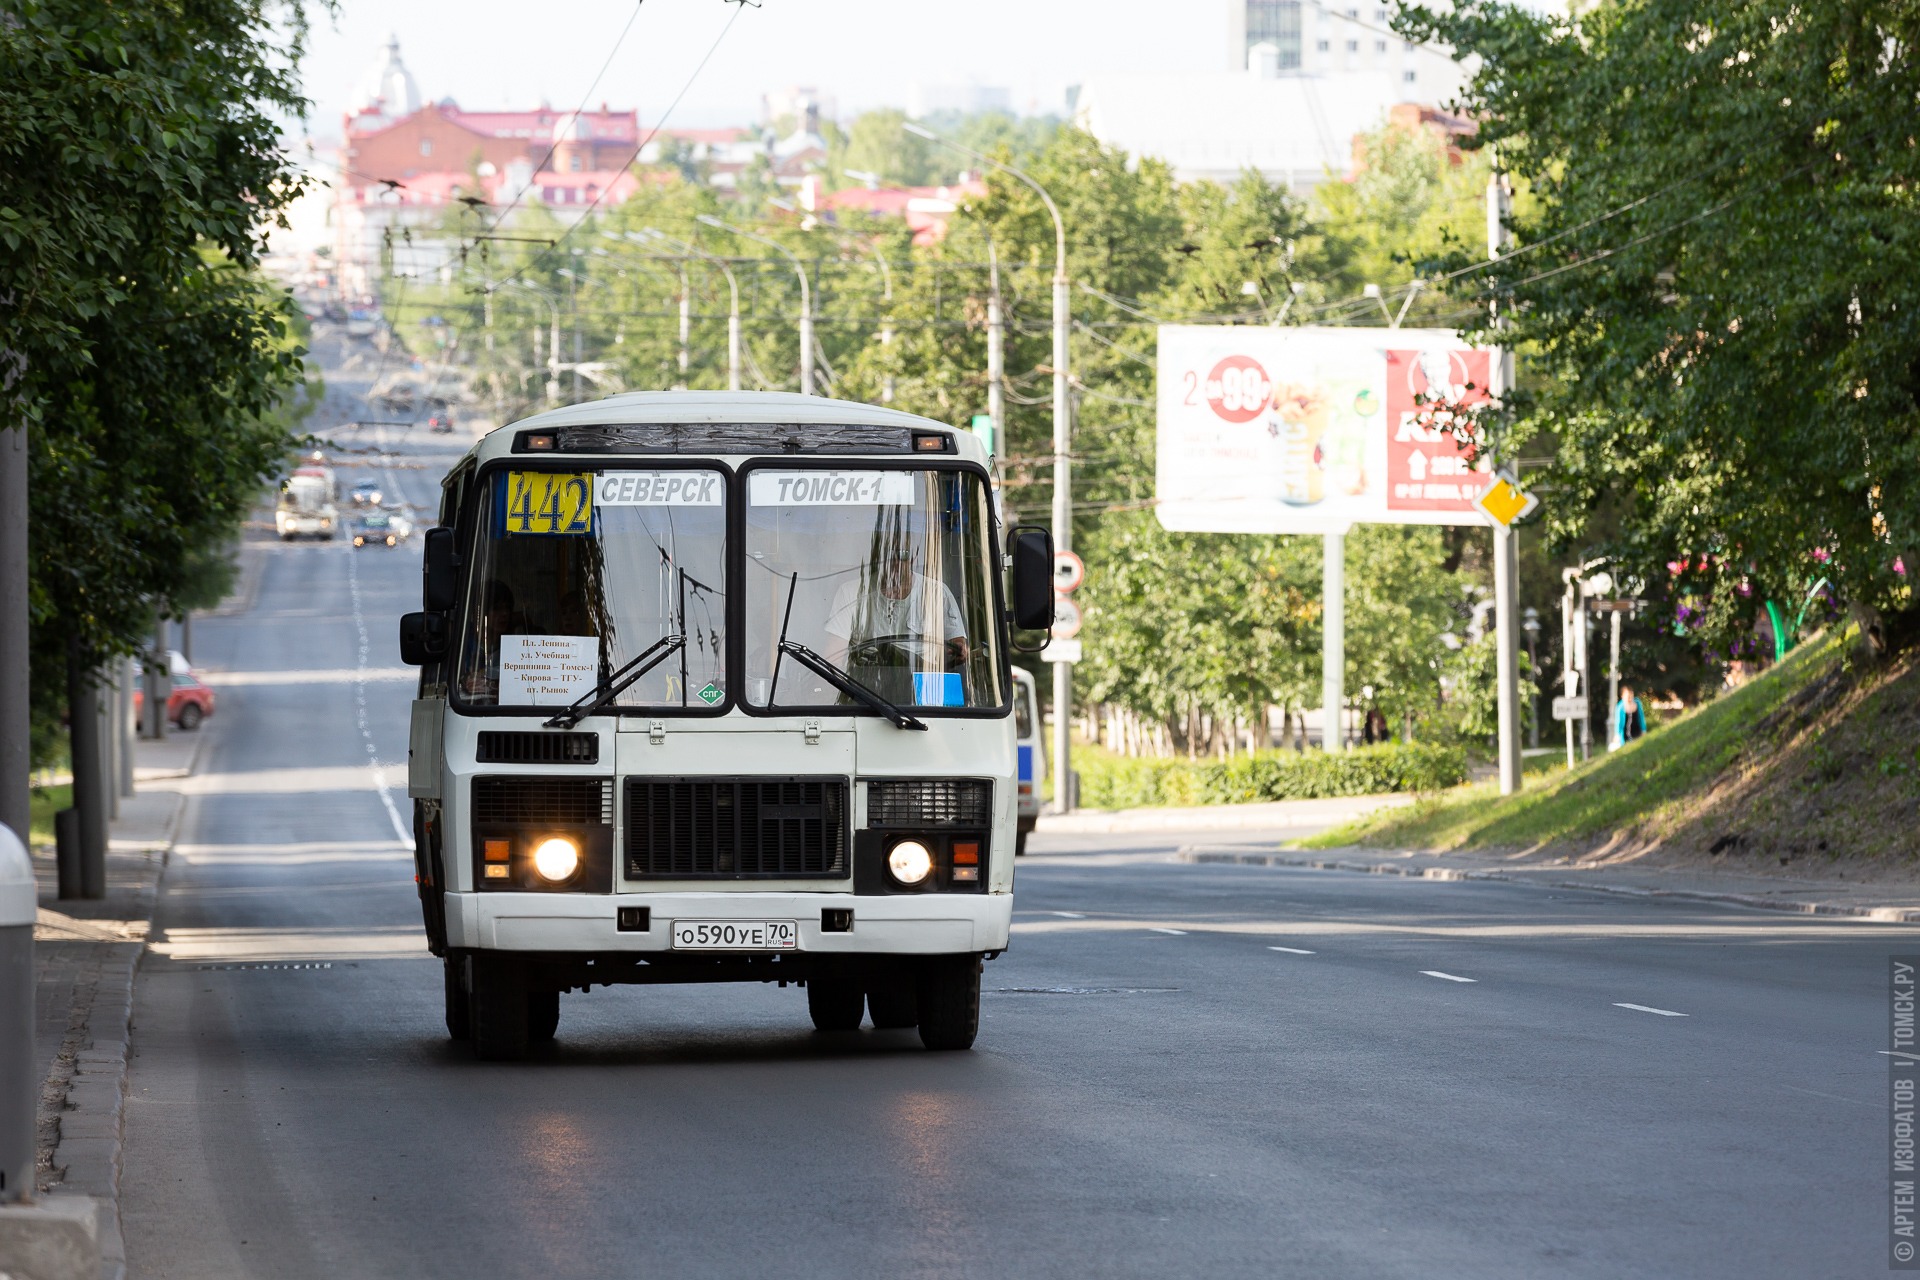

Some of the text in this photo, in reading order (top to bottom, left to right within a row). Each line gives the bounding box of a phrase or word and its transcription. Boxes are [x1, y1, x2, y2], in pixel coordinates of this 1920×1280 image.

[603, 477, 715, 502] СЕВЕРСК
[778, 477, 882, 502] ТОМСК-1
[509, 474, 590, 532] 442
[522, 639, 536, 647] Пл.
[538, 639, 570, 647] Ленина
[535, 651, 570, 659] Учебная
[504, 662, 551, 671] Вершинина
[560, 663, 593, 671] Томск-1
[521, 673, 552, 683] Кирова
[541, 686, 569, 694] Рынок
[769, 924, 789, 939] 70
